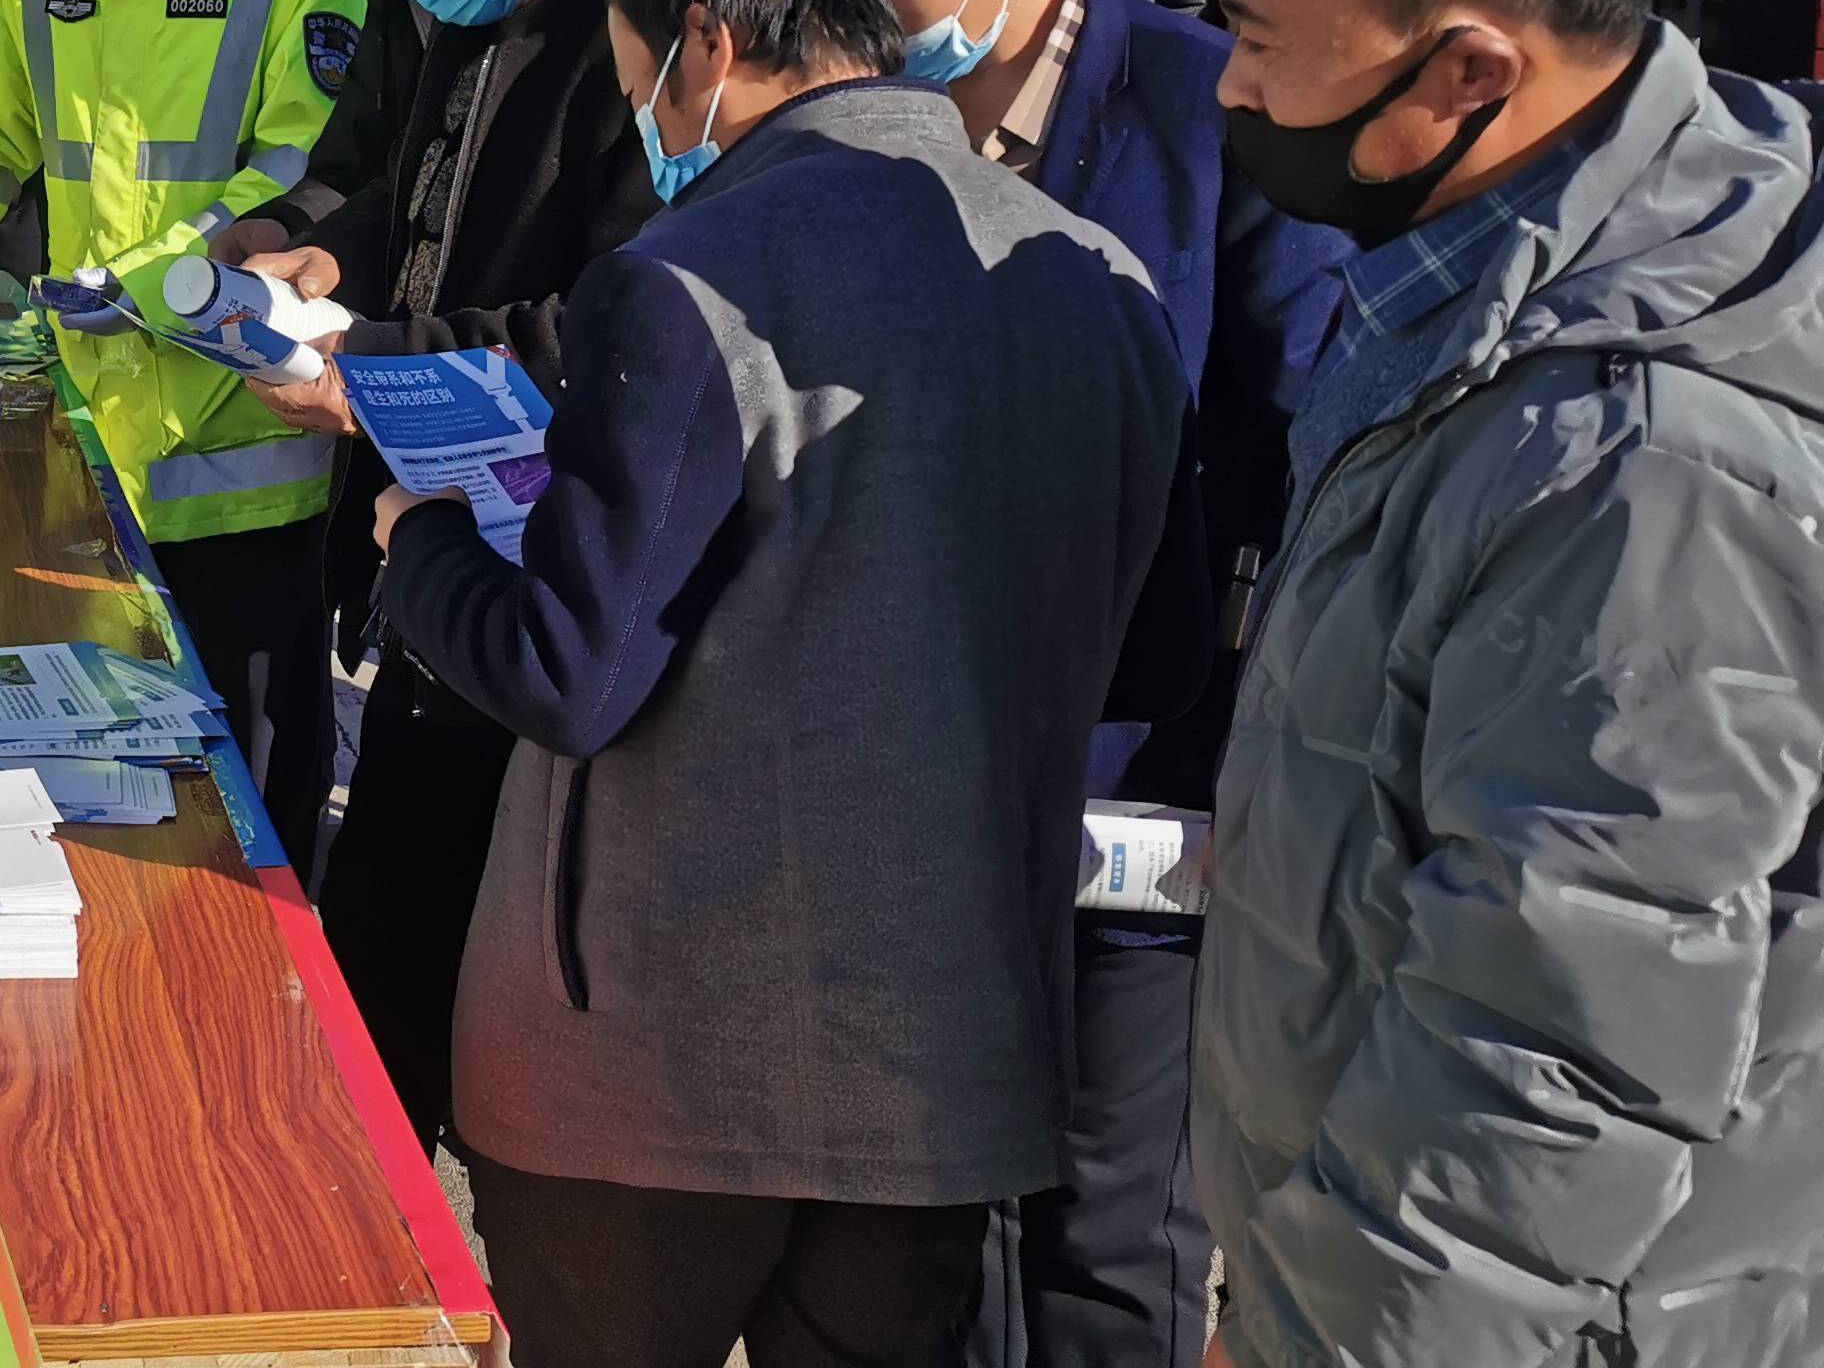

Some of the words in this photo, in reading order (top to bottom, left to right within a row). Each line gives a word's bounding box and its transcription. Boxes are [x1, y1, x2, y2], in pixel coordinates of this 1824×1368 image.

[362, 387, 456, 407] 是生和死的区别
